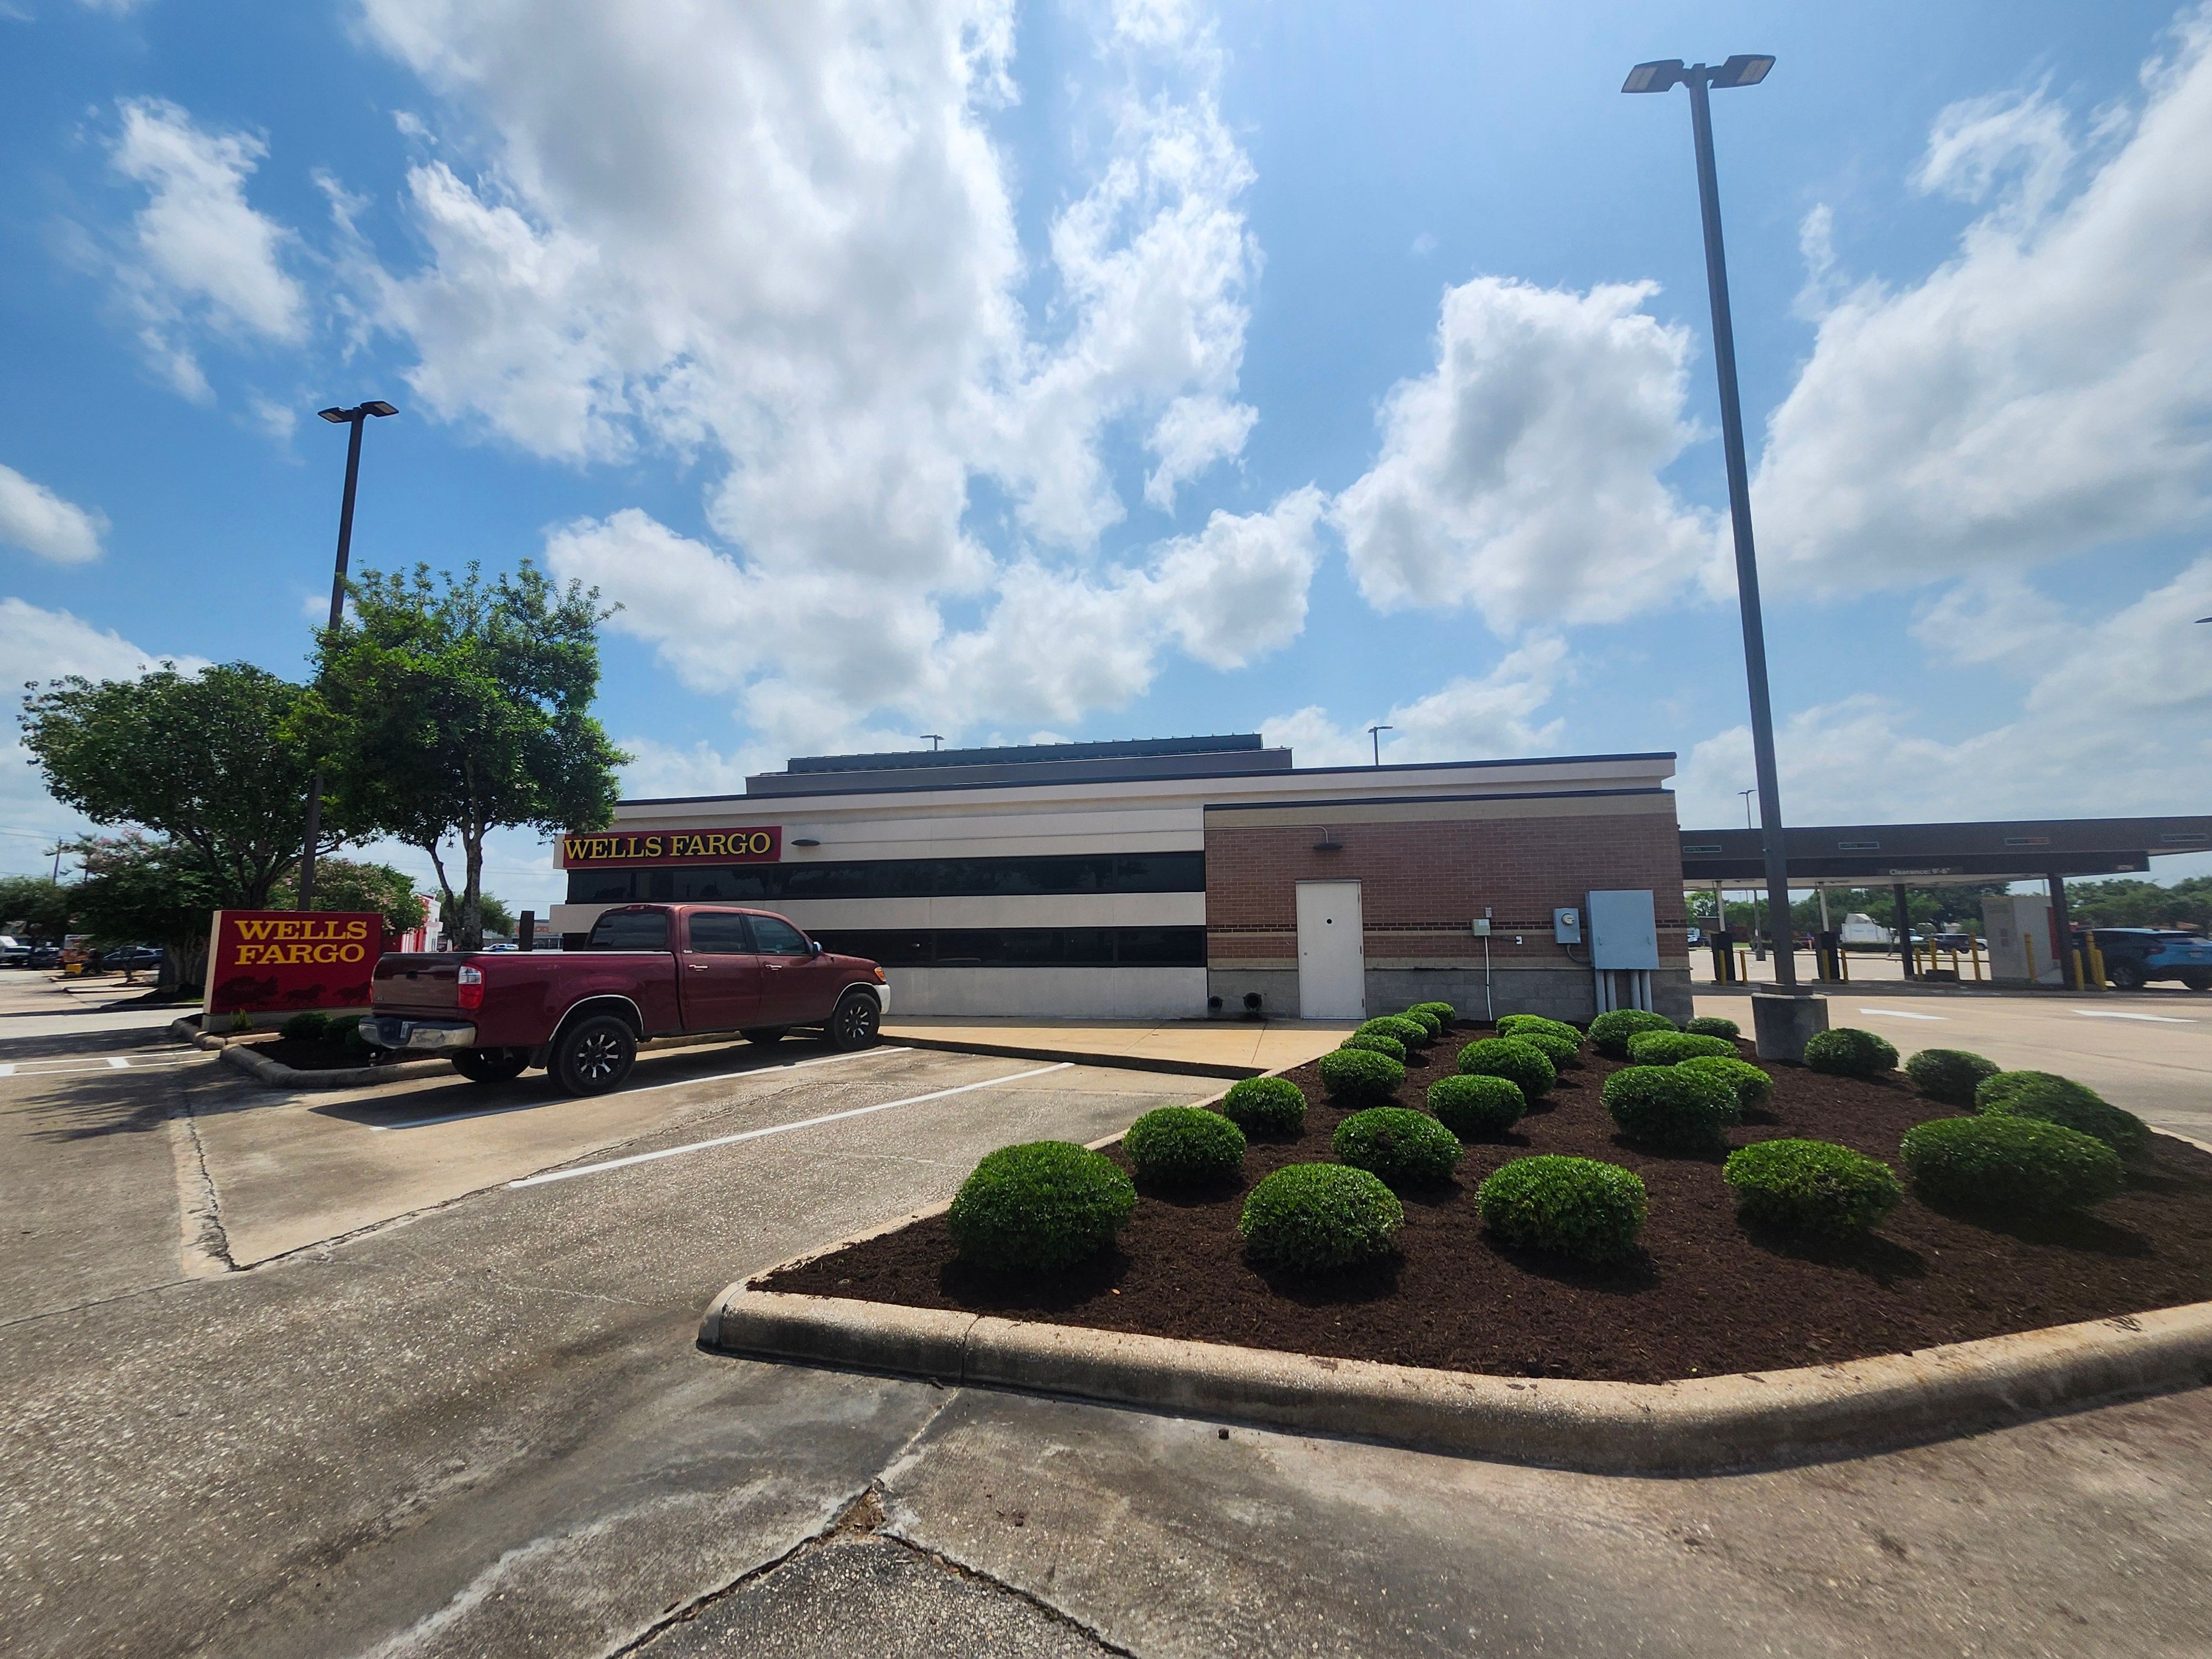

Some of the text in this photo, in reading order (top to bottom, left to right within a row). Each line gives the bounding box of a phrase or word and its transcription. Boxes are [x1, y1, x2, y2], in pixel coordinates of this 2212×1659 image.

[563, 832, 771, 859] WELLS FARGO
[234, 920, 367, 940] WELLS
[234, 943, 365, 965] FARGO
